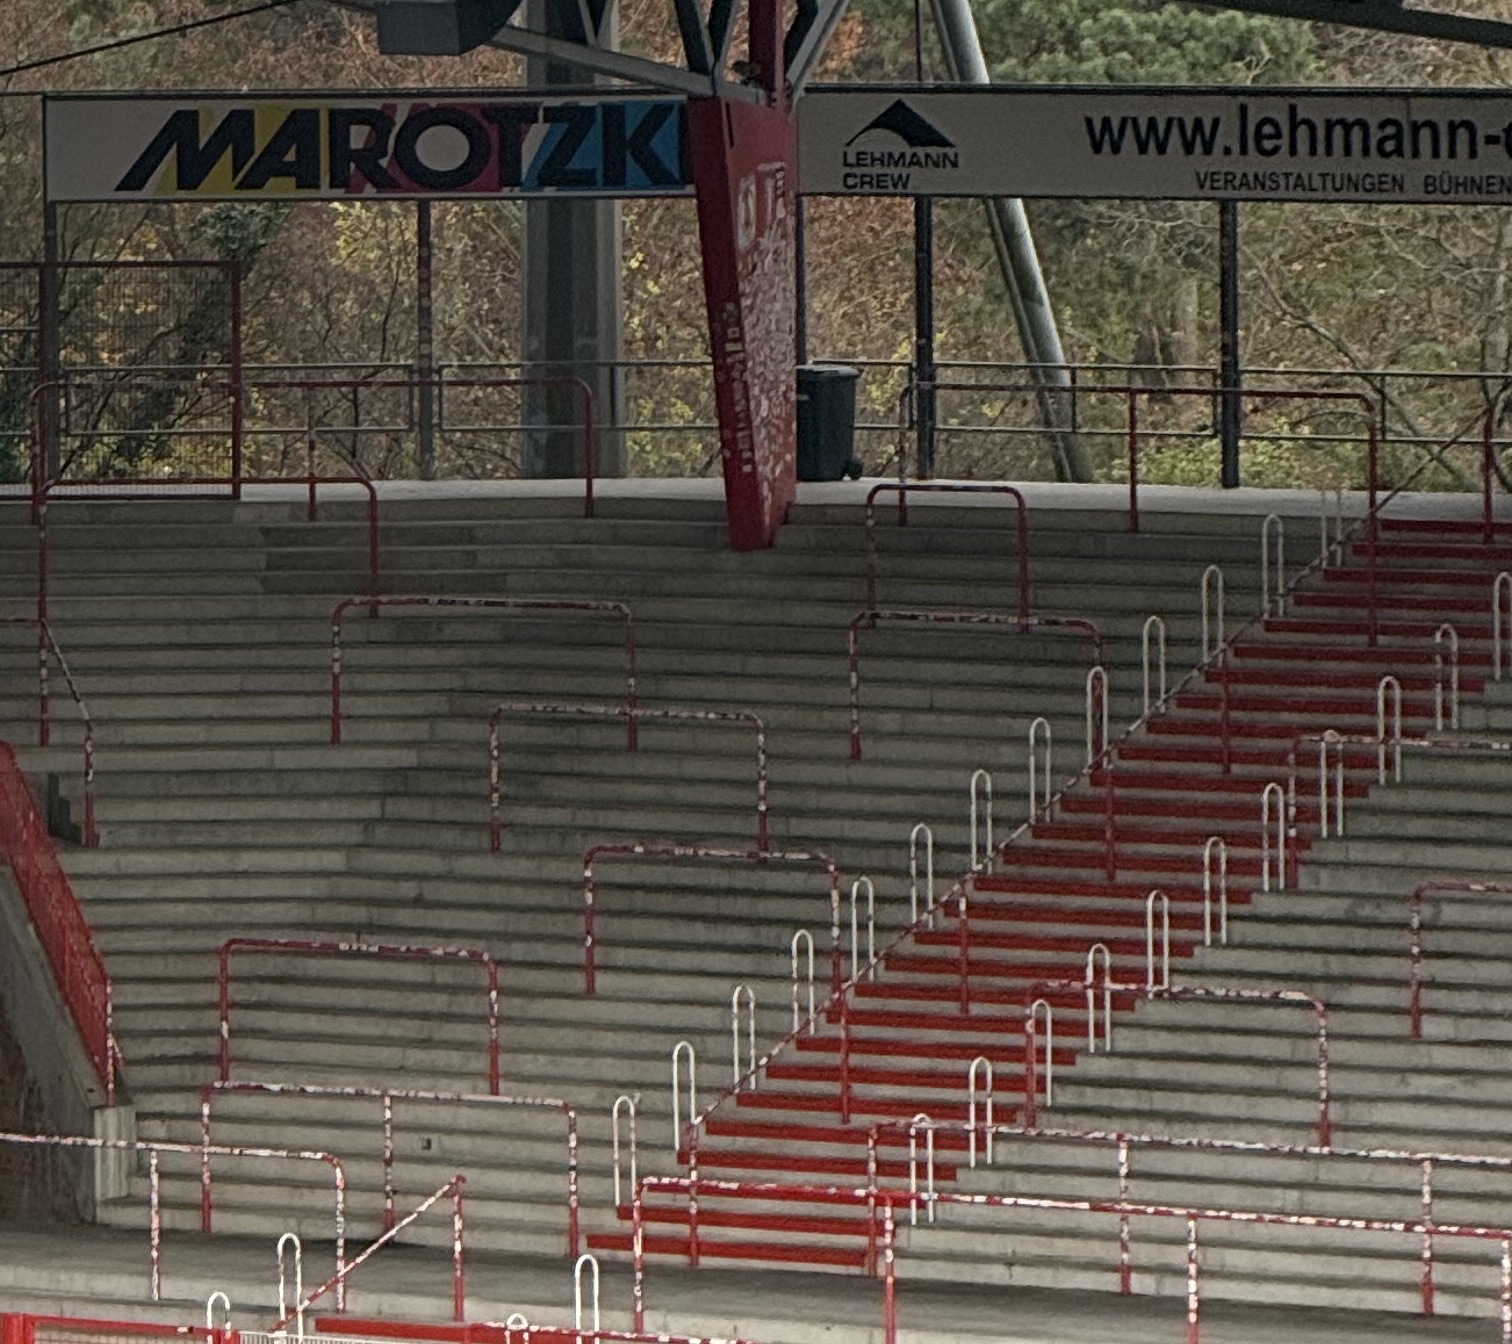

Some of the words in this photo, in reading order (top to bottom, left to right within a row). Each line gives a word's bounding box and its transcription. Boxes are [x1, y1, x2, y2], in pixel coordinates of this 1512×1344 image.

[114, 102, 693, 192] MAROTZK
[842, 150, 959, 169] LEHMANN
[842, 172, 911, 190] CREW
[1196, 170, 1405, 194] VERANSTALTUNGEN
